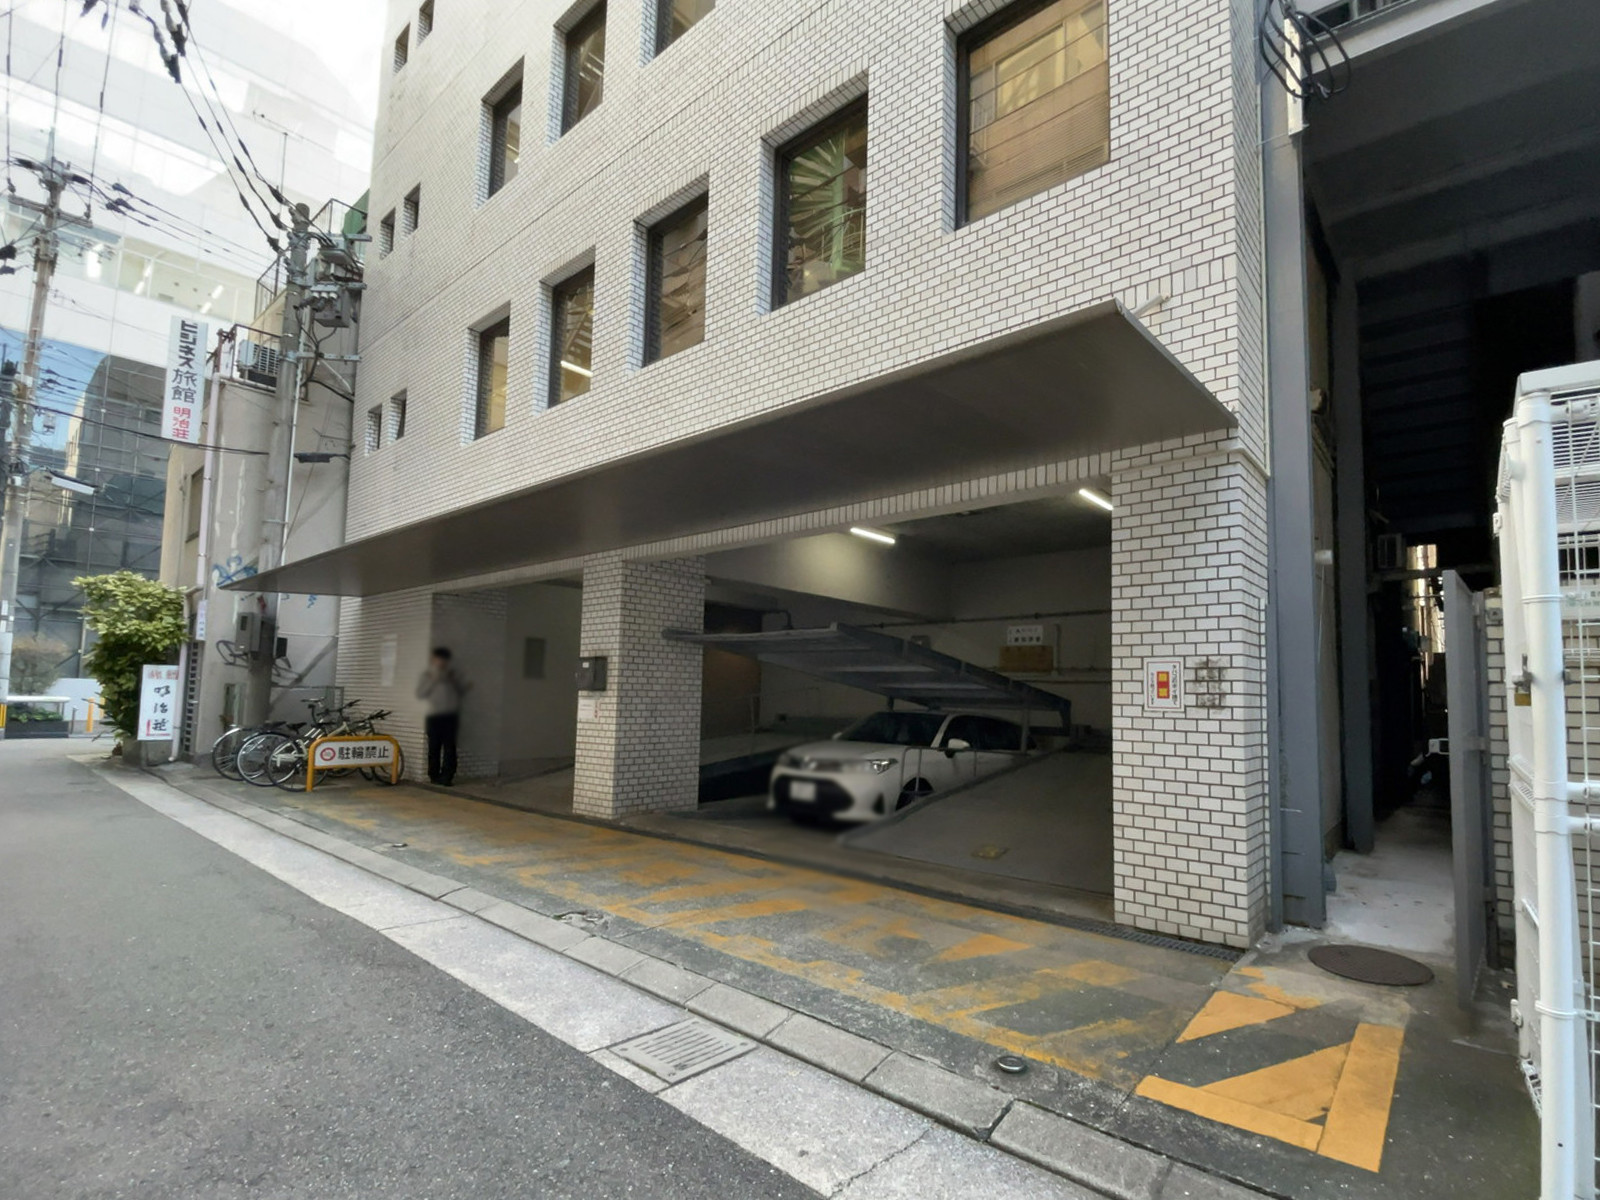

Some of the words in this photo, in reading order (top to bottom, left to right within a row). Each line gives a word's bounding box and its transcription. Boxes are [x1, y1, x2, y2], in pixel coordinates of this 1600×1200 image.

[172, 320, 198, 404] ビジネス旅館
[172, 406, 191, 439] 明治荘
[337, 745, 389, 760] 駐輪禁止
